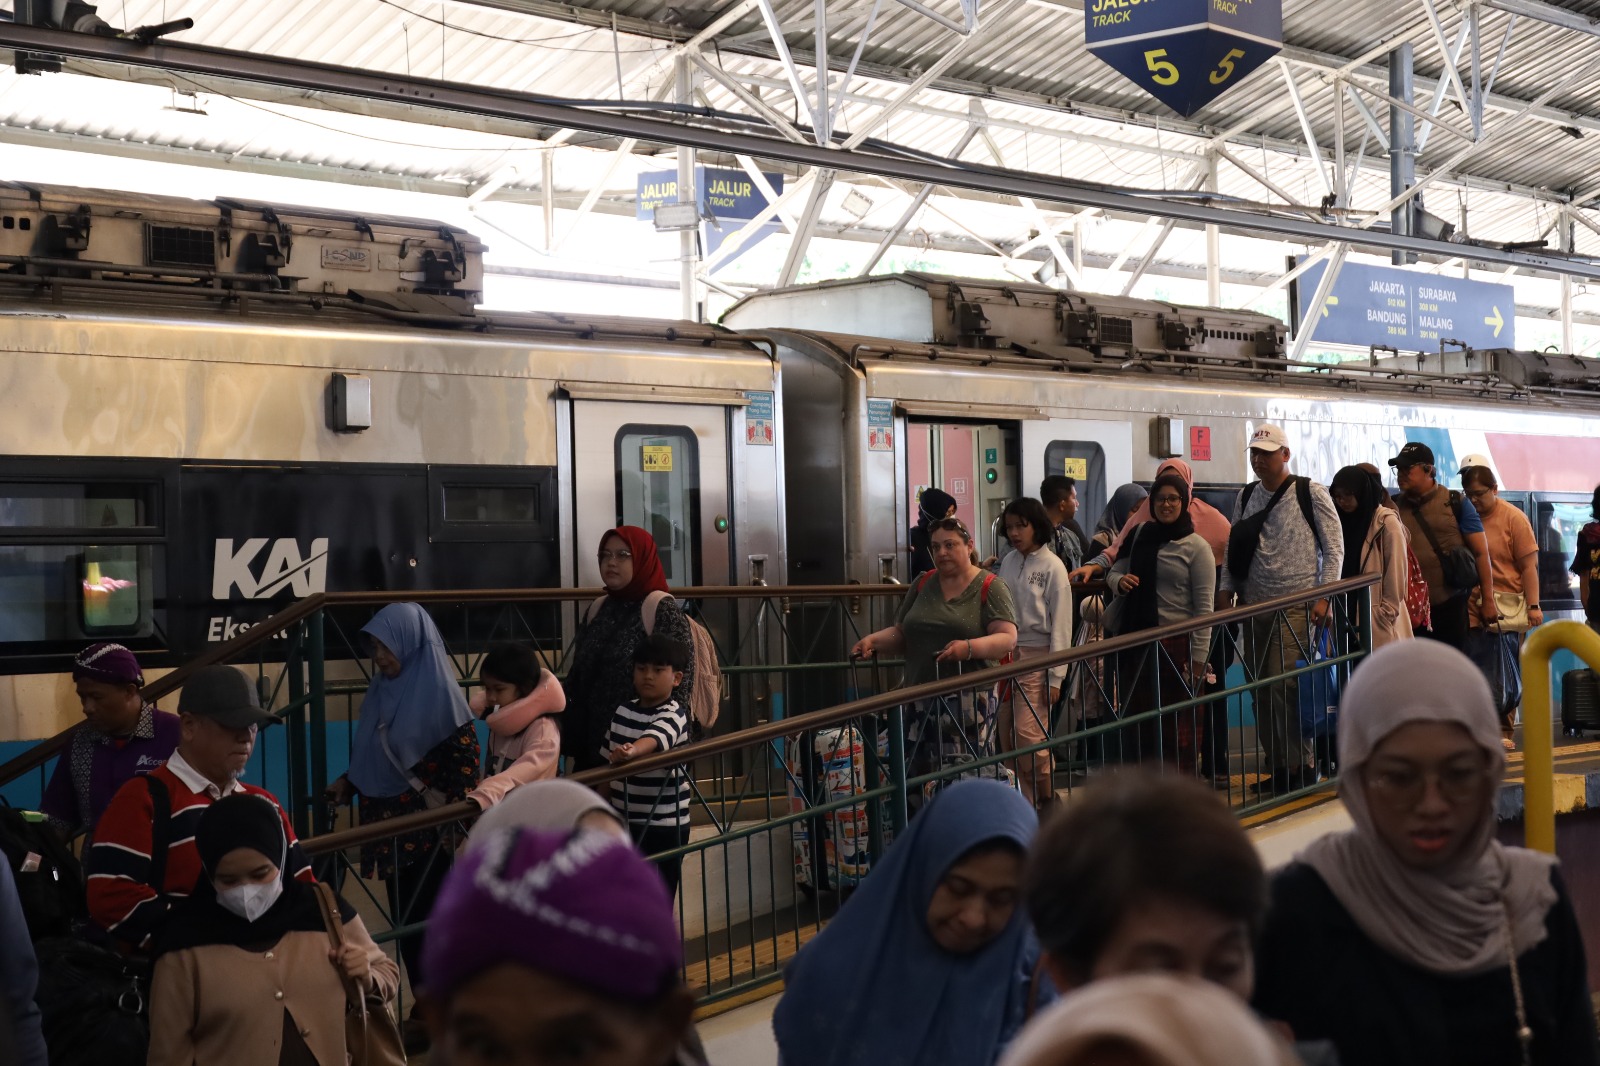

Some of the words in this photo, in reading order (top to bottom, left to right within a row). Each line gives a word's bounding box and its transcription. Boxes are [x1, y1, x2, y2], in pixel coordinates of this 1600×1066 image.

[1213, 0, 1238, 16] TRACK
[1092, 9, 1132, 28] TRACK
[1144, 48, 1180, 86] 5
[1208, 48, 1246, 85] 5
[641, 182, 677, 199] JALUR
[708, 179, 752, 197] JALUR
[708, 196, 736, 208] TRACK
[1369, 281, 1405, 295] JAKARTA
[1419, 287, 1457, 303] SURABAYA
[1397, 299, 1405, 308] KM
[1429, 304, 1438, 312] KM
[1368, 309, 1406, 325] BANDUNG
[1420, 316, 1453, 330] MALANG
[1398, 327, 1406, 336] KM
[1429, 331, 1438, 340] KM
[1198, 430, 1204, 443] F
[212, 537, 329, 600] KAI
